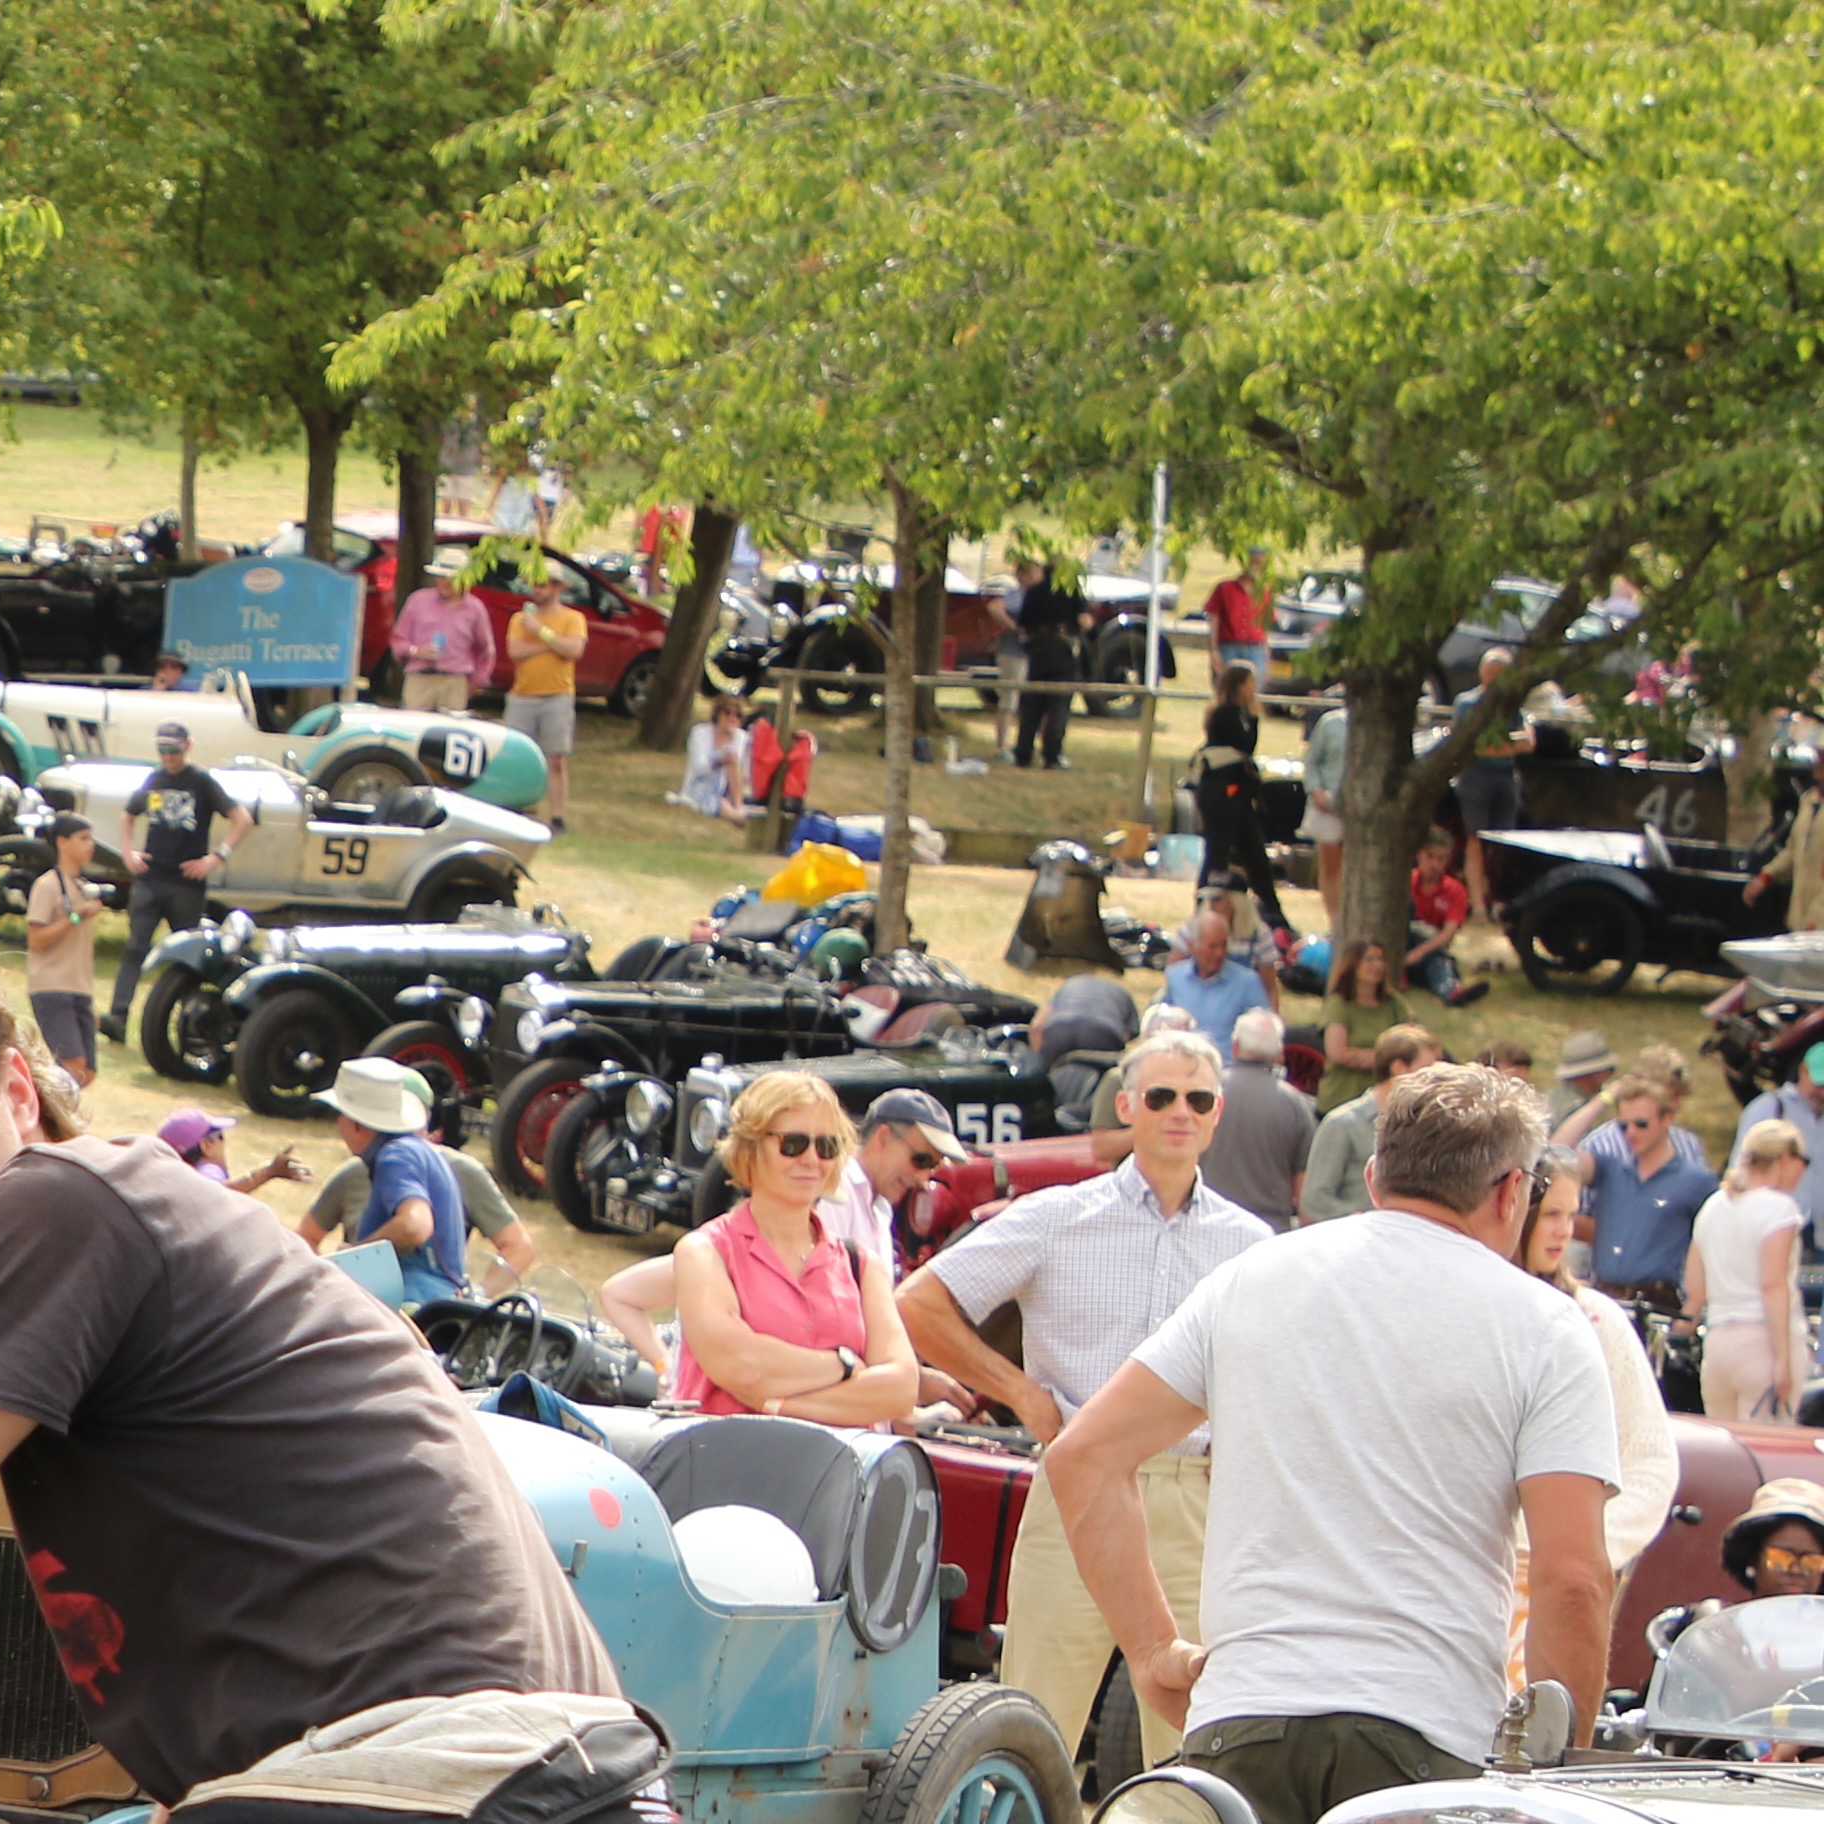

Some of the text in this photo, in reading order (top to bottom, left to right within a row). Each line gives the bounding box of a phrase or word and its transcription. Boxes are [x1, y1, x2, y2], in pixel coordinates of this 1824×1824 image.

[239, 605, 281, 631] The
[175, 637, 341, 668] Bugatti Terrace
[444, 732, 484, 779] 61
[1634, 784, 1700, 835] 46
[321, 836, 370, 876] 59
[956, 1102, 1023, 1145] 56
